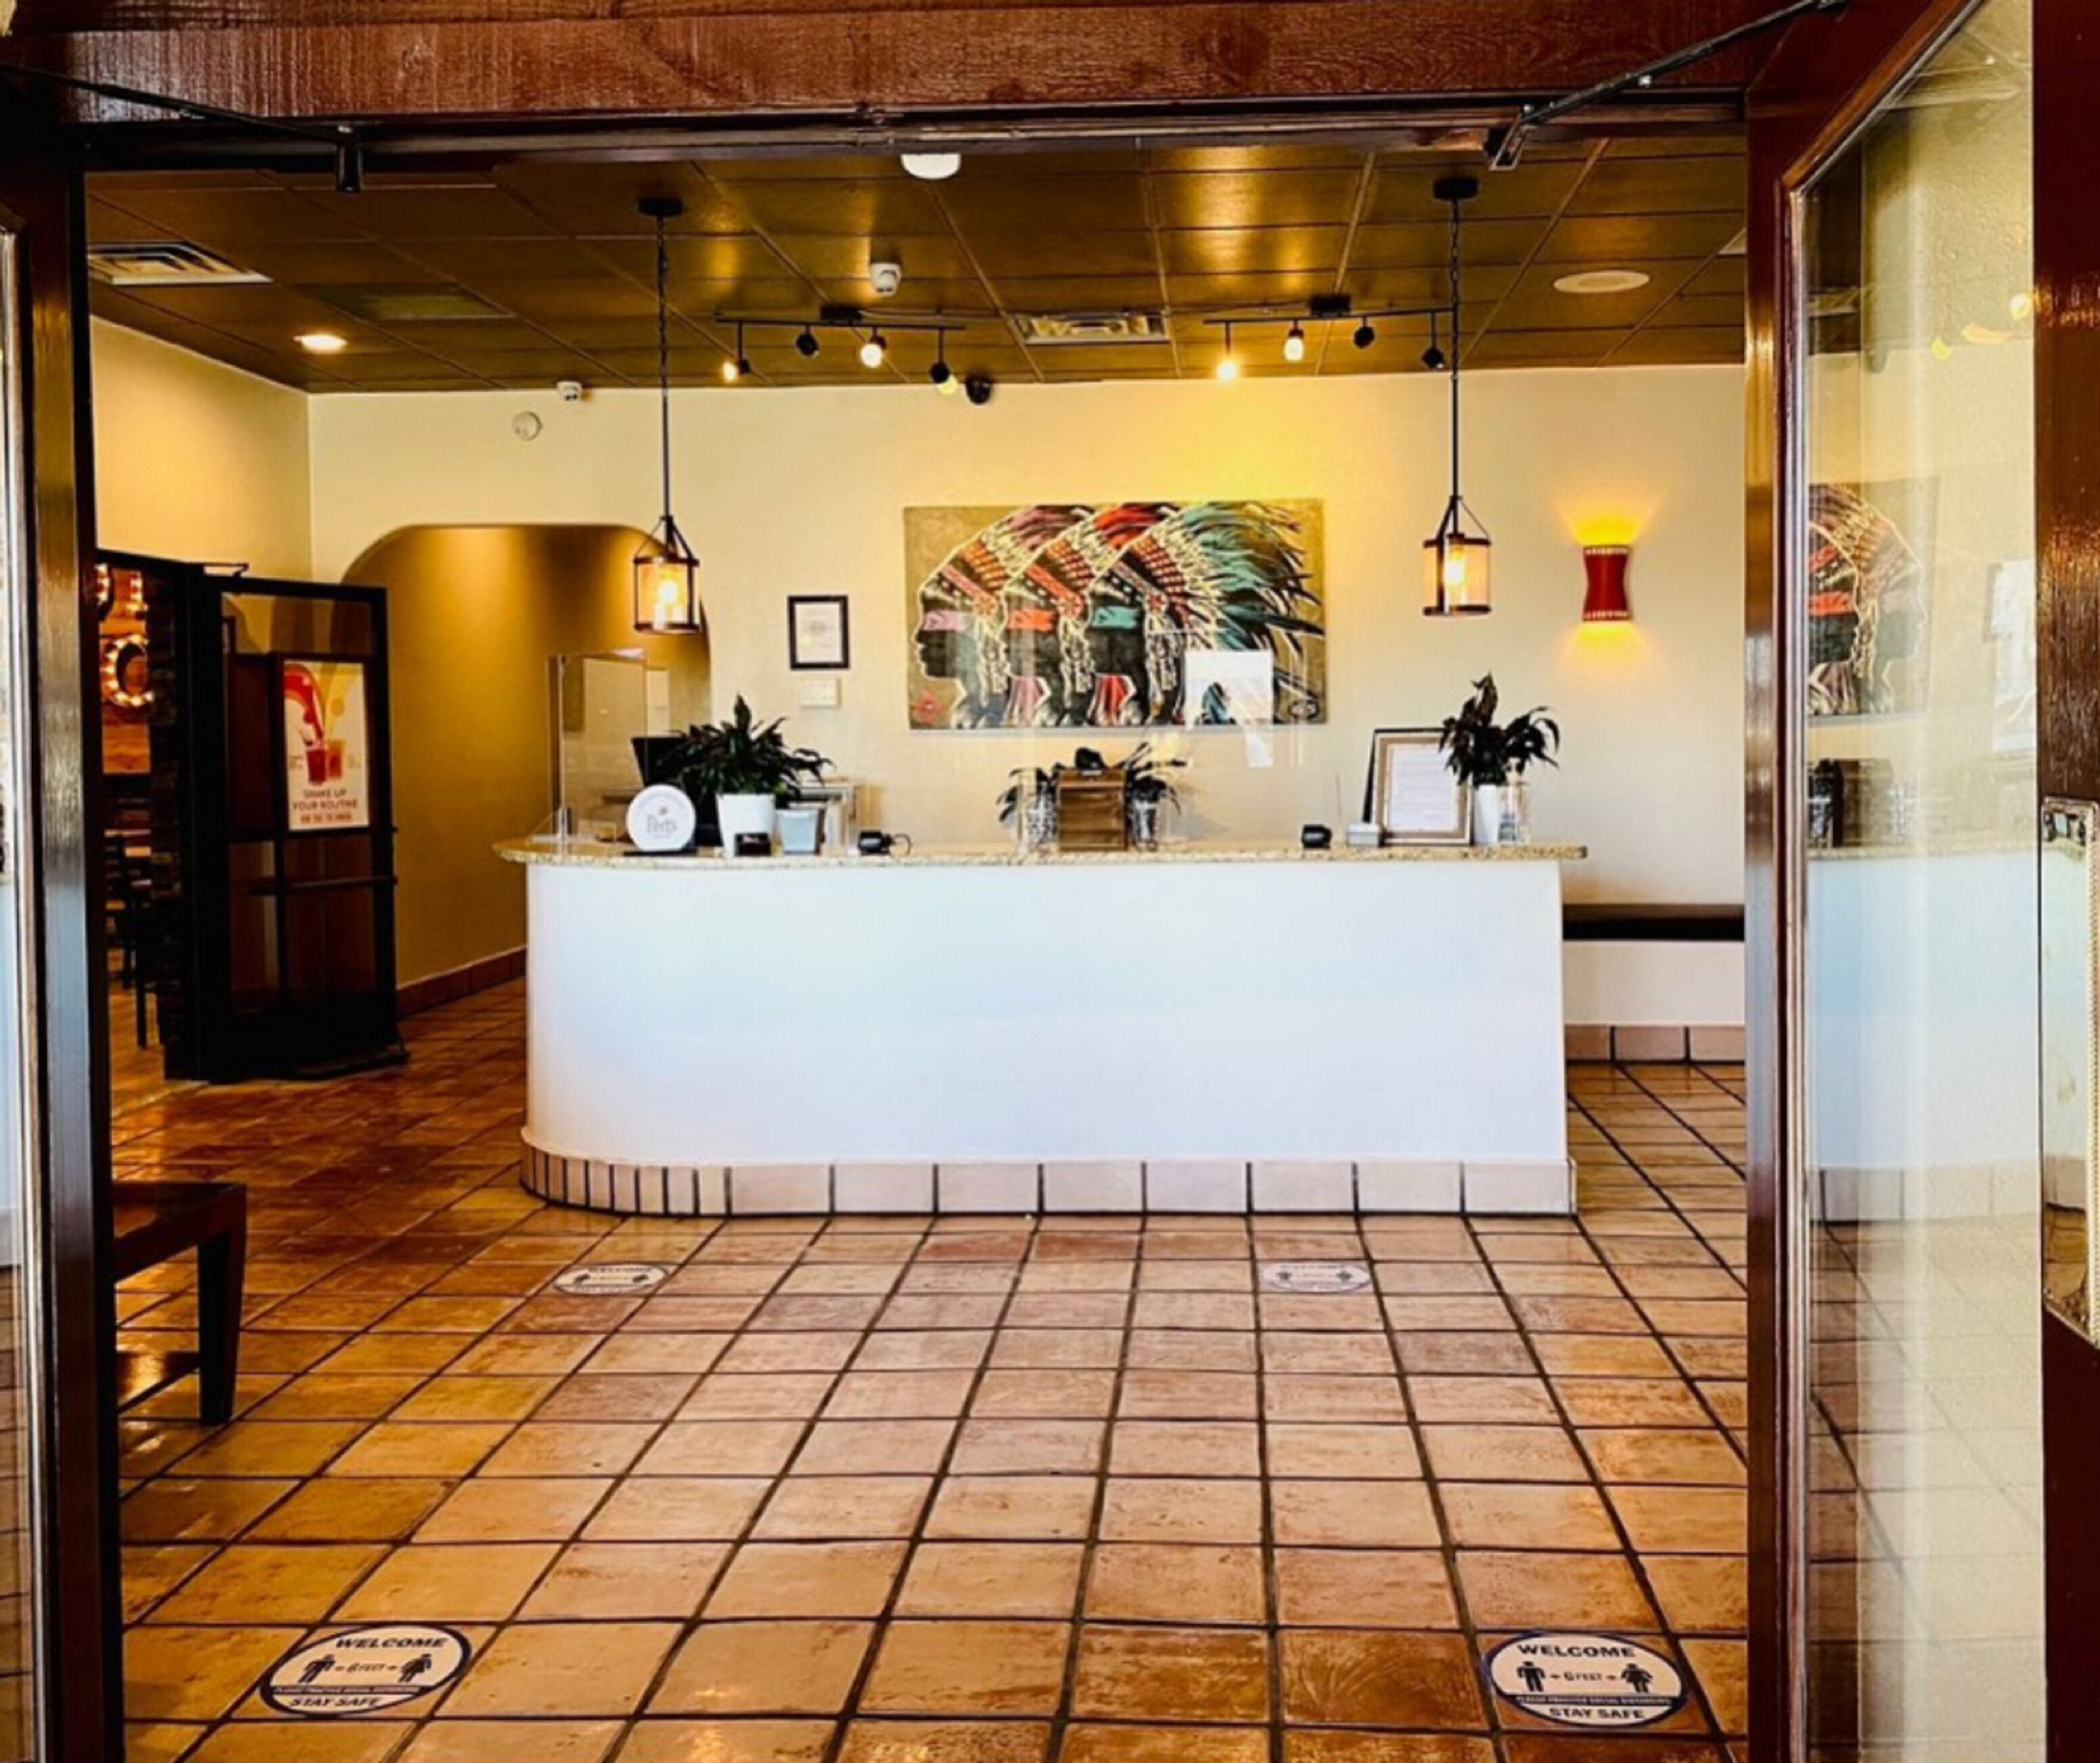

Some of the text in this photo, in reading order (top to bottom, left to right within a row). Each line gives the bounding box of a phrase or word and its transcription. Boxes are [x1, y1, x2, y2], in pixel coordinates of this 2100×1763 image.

[293, 800, 318, 810] YOUR
[336, 1638, 448, 1648] WELCOME
[1517, 1644, 1635, 1657] WELCOME
[288, 1695, 381, 1707] STAY SAFE
[1549, 1707, 1646, 1719] STAY SAFE
